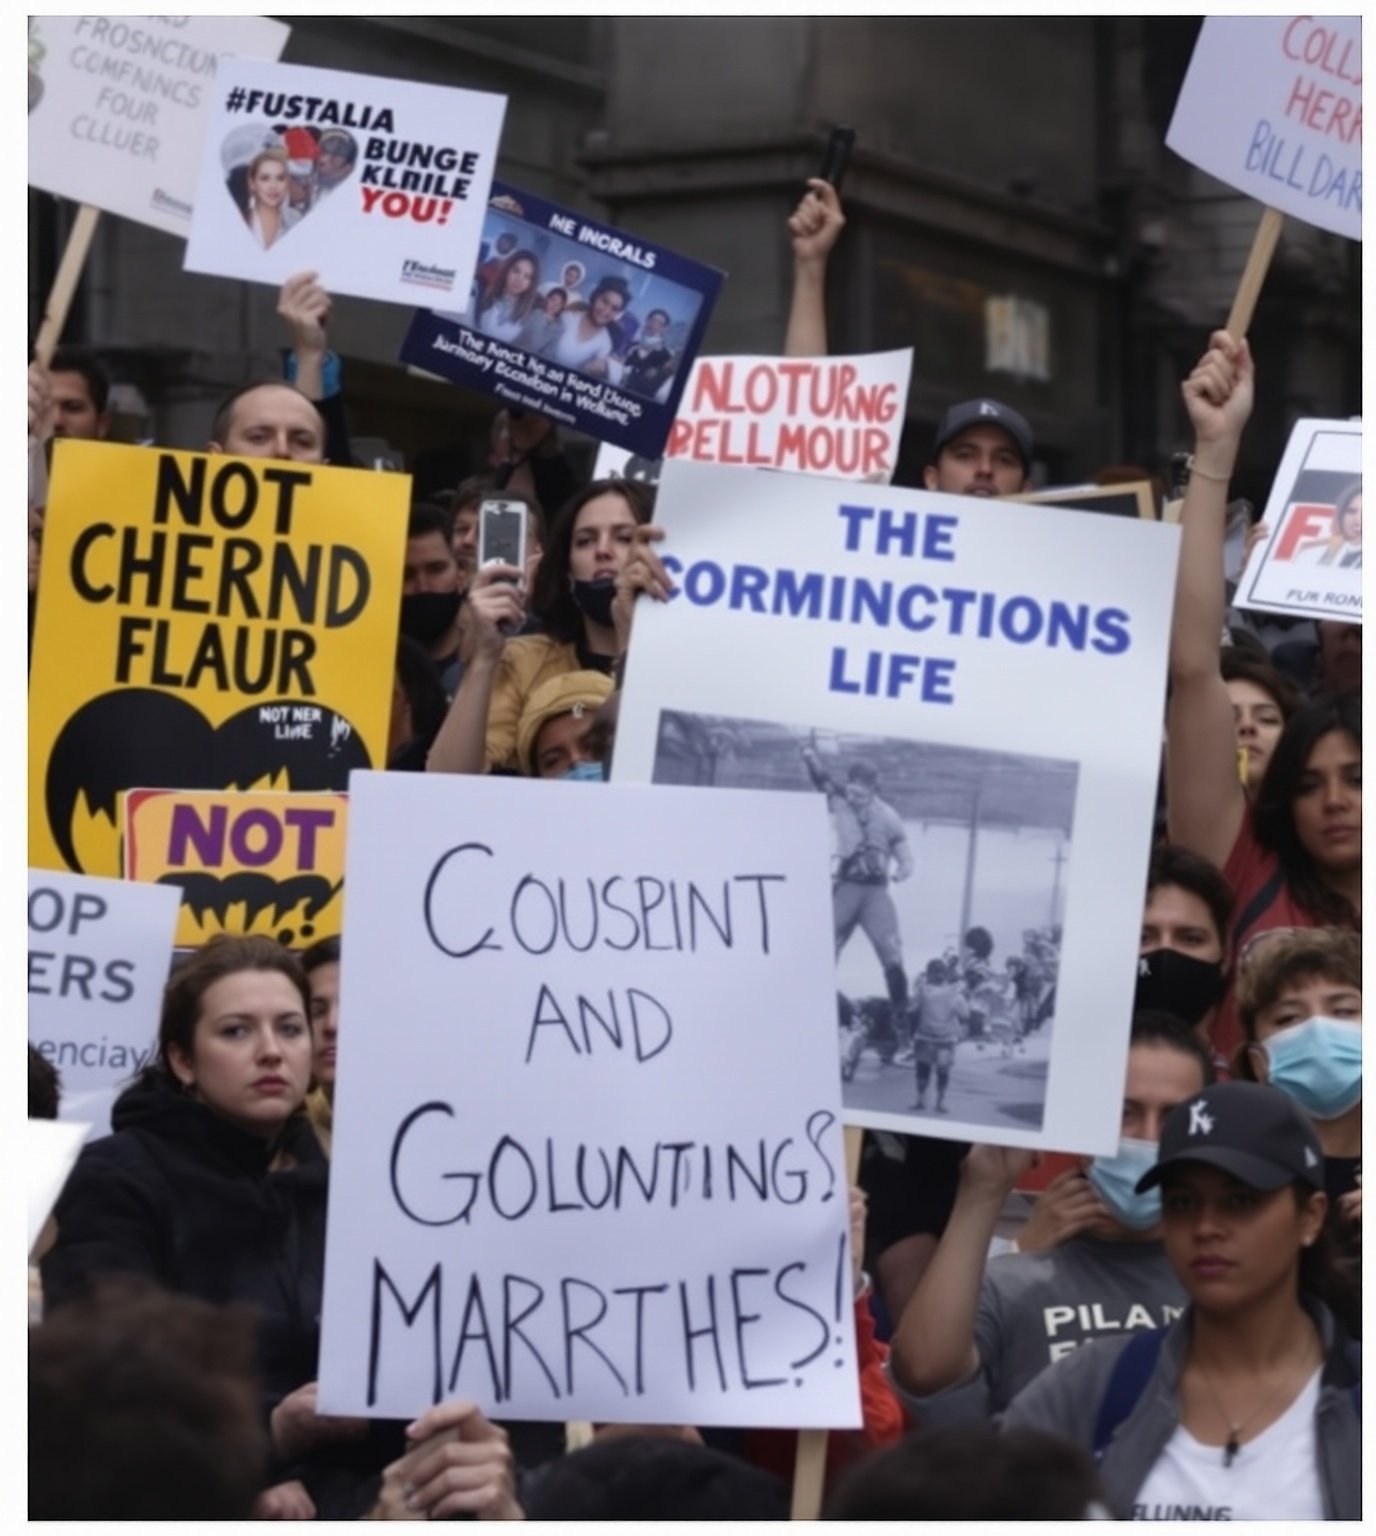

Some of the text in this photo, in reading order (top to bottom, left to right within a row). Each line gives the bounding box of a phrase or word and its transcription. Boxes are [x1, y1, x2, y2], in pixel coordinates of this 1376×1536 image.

[1283, 16, 1361, 85] COLL
[226, 87, 394, 134] #FUSTALIA
[364, 137, 480, 175] BUNGE
[360, 187, 453, 225] YOU!
[153, 454, 312, 535] NOT
[838, 504, 958, 562] THE
[70, 522, 371, 628] CHERND
[115, 615, 317, 697] FLAUR
[829, 646, 957, 705] LIFE
[259, 706, 290, 723] NOT
[167, 804, 336, 871] NOT
[524, 982, 673, 1064] AND
